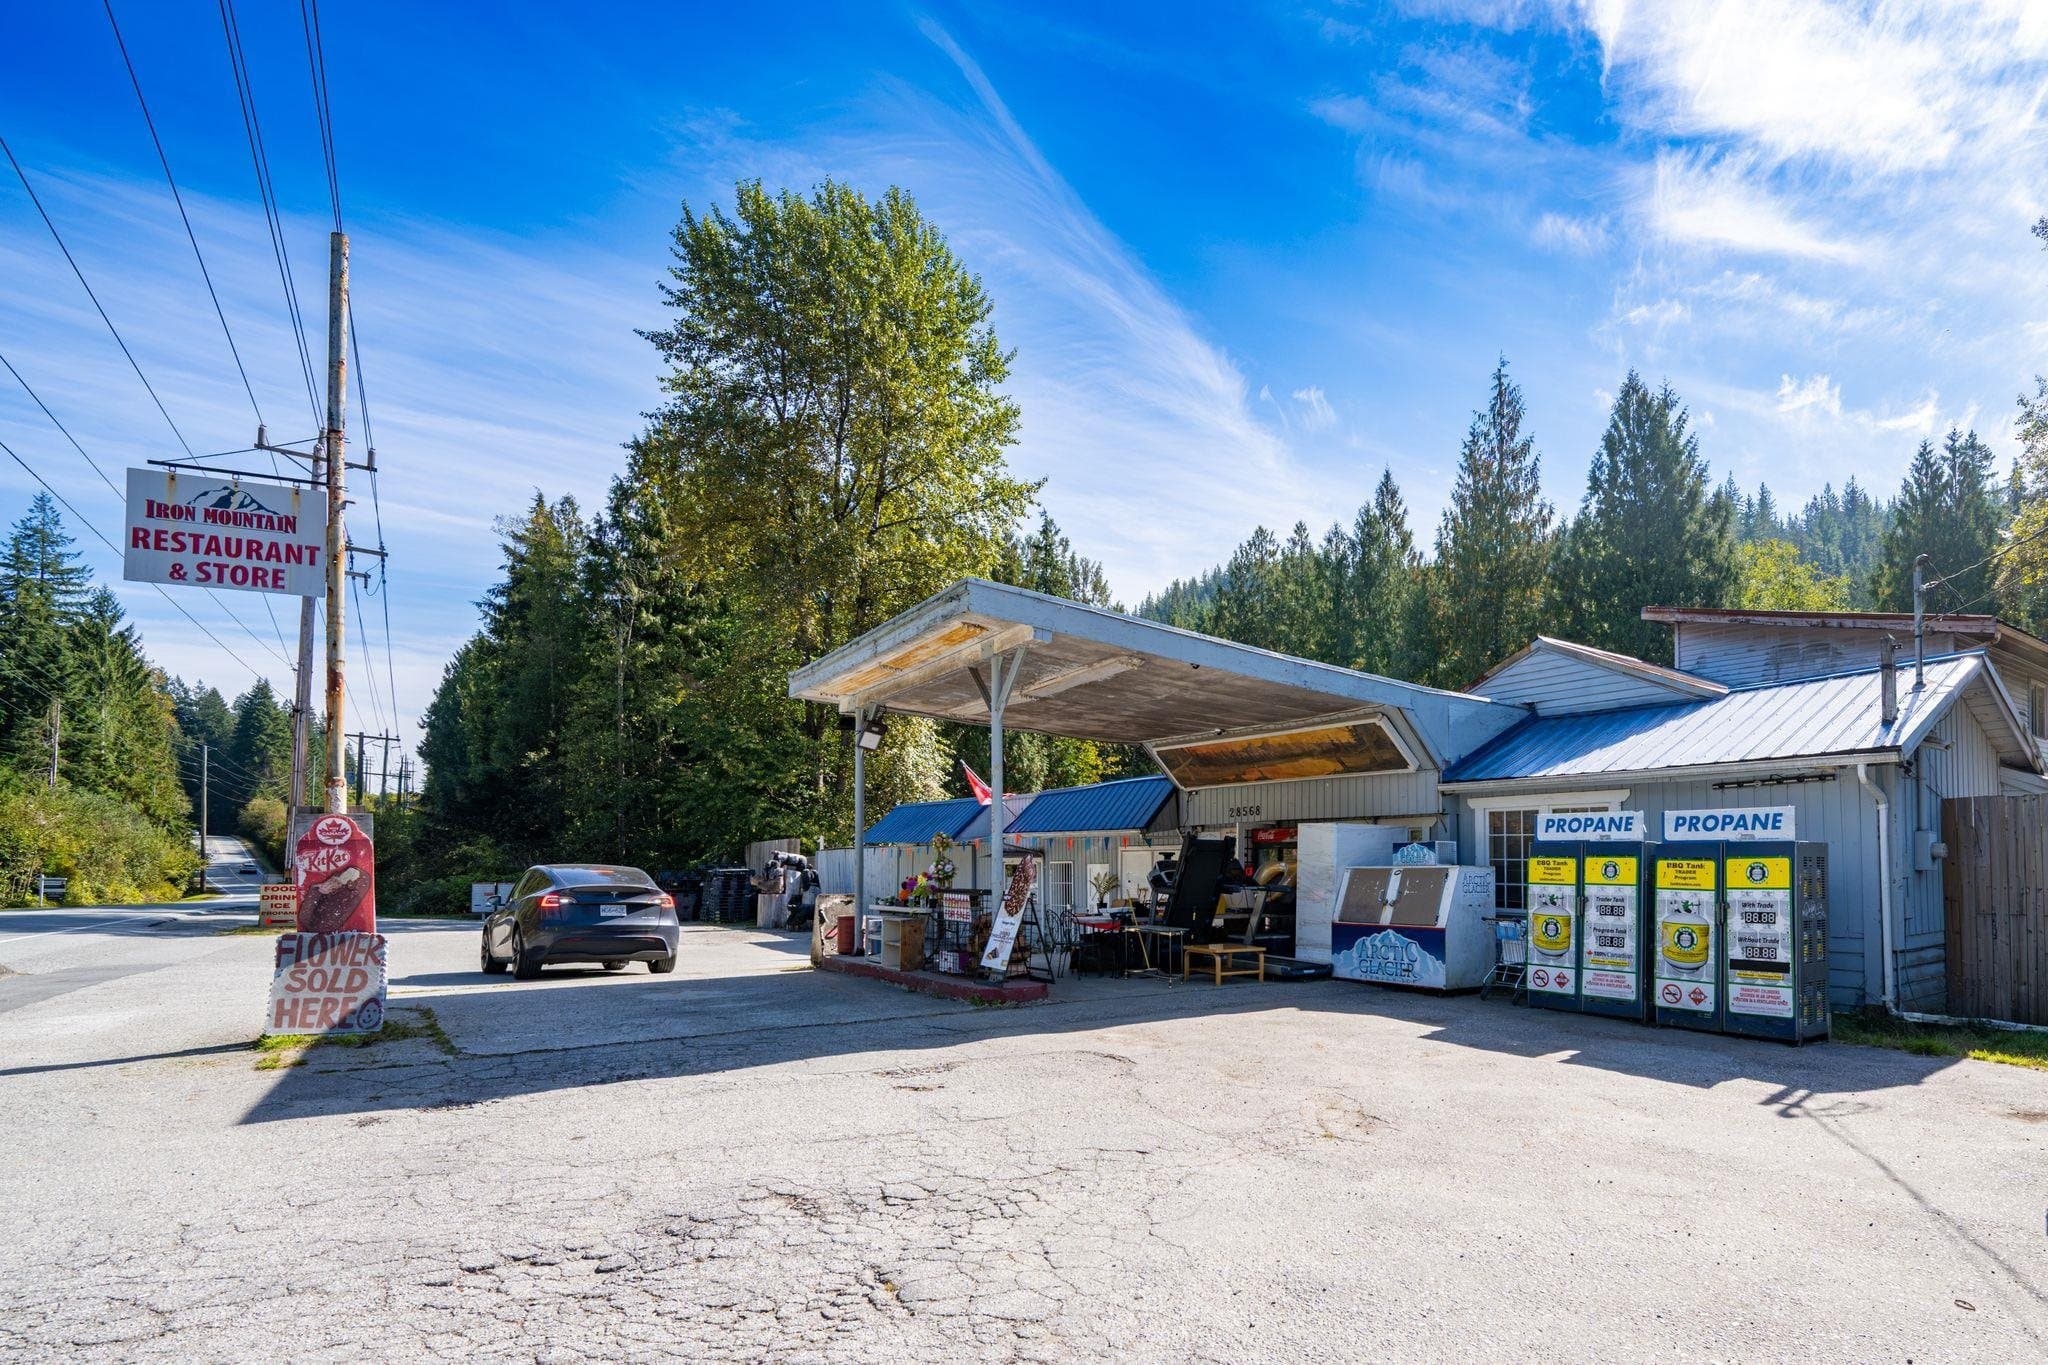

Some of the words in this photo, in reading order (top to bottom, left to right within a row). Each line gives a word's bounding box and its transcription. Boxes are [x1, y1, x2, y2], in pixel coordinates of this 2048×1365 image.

[145, 499, 196, 522] IRON
[203, 507, 297, 534] MOUNTAIN
[131, 526, 321, 567] RESTAURANT
[168, 563, 188, 581] &
[196, 562, 286, 590] STORE
[1229, 806, 1261, 817] 28568
[1544, 815, 1634, 833] PROPANE
[1673, 812, 1784, 832] PROPANE
[275, 933, 384, 968] FLOWER
[1358, 938, 1418, 963] ARCTIC
[1737, 936, 1761, 944] Without
[284, 968, 369, 994] SOLD
[1358, 958, 1418, 979] GLACIER
[274, 997, 358, 1030] HERE
